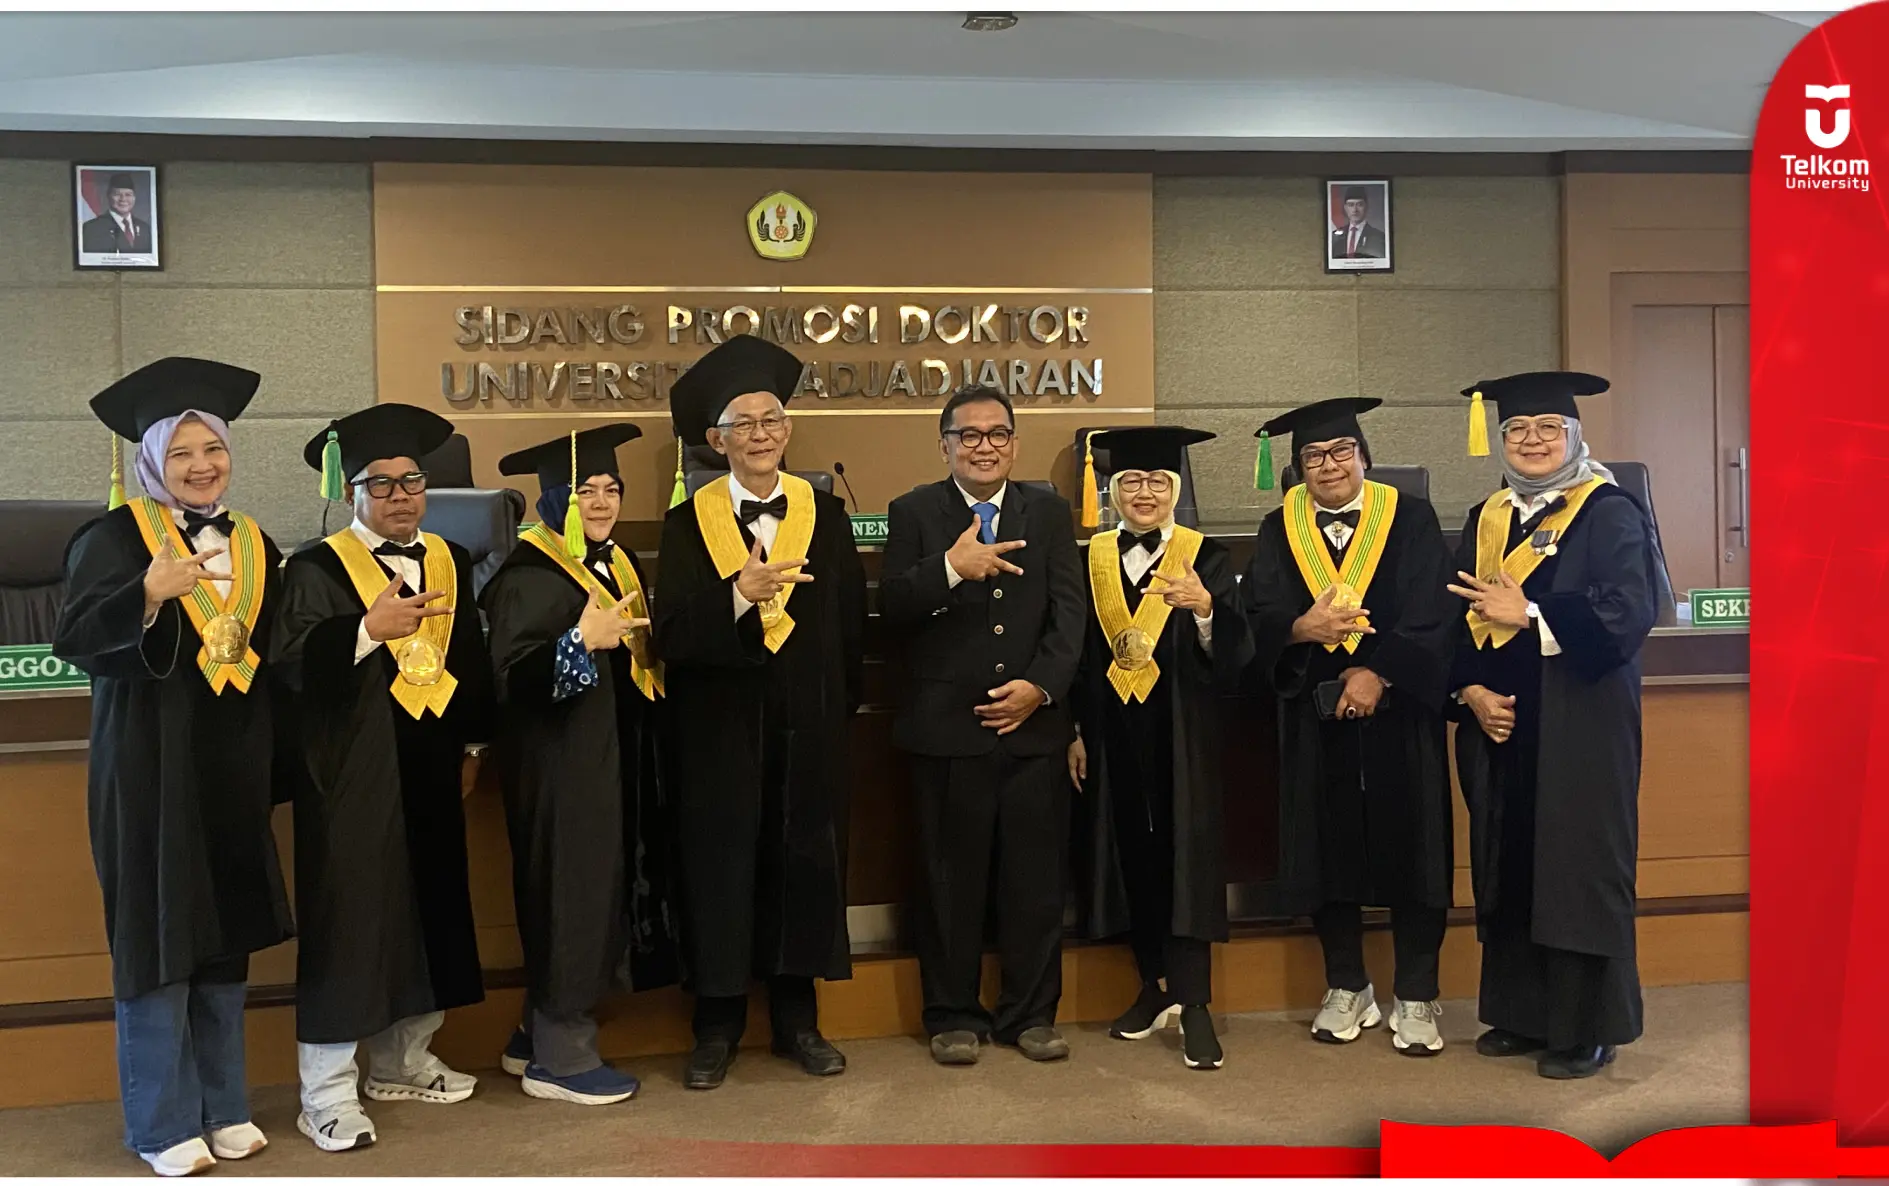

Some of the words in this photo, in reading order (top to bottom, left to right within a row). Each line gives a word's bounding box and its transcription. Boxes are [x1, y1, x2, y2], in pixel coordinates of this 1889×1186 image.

[454, 304, 645, 345] SIDANG
[667, 303, 879, 344] PROMOSI
[899, 304, 1091, 344] DOKTOR
[441, 361, 695, 401] UNIVERSI
[790, 358, 1103, 398] ADJADJARAN
